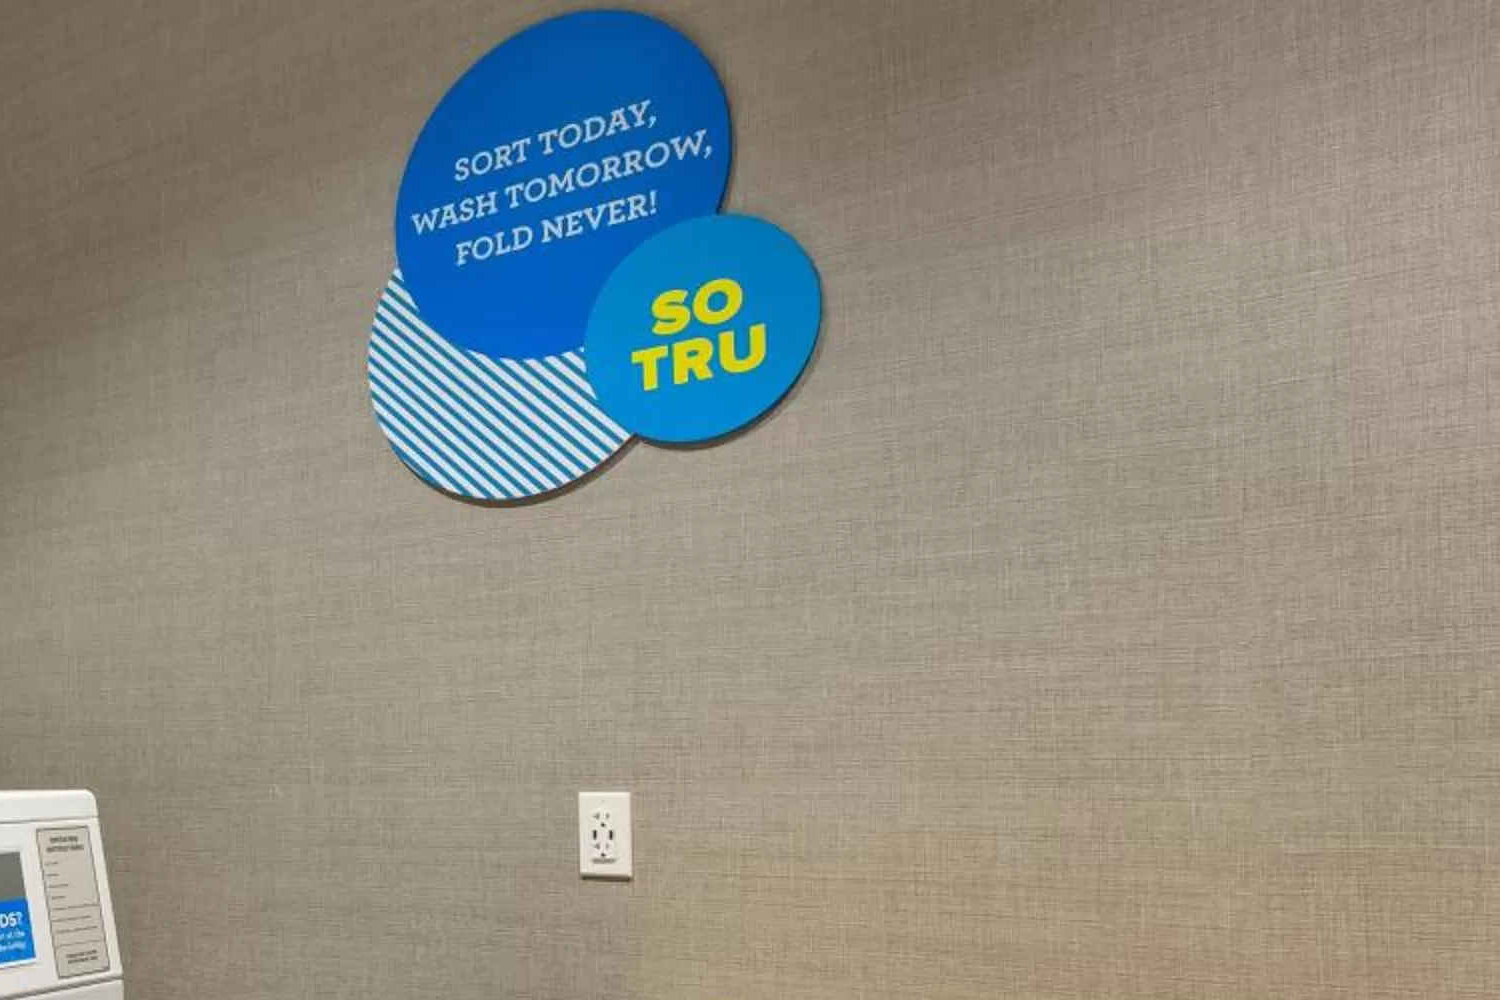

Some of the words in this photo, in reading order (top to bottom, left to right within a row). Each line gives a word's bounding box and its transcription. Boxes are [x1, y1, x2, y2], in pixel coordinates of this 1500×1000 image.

[456, 138, 530, 180] SORT
[539, 101, 656, 154] TODAY,
[412, 192, 497, 234] WASH
[505, 130, 711, 208] TOMORROW,
[457, 227, 532, 265] FOLD
[542, 191, 656, 242] NEVER!
[650, 278, 743, 335] SO
[631, 323, 766, 391] TRU
